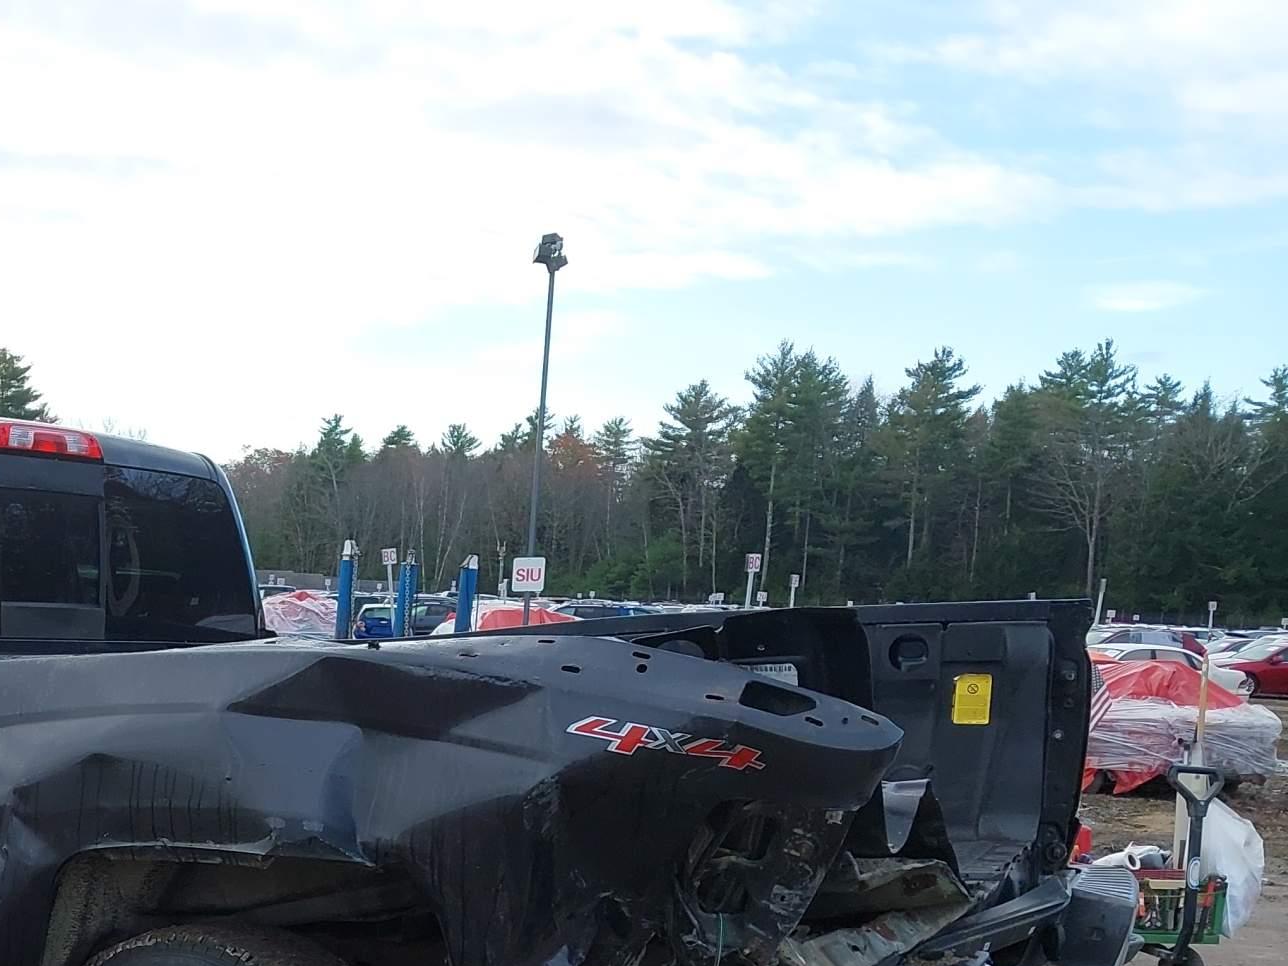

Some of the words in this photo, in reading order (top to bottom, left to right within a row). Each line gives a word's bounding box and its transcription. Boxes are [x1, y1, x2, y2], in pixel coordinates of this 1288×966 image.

[383, 550, 396, 562] BC
[748, 555, 761, 570] BC
[515, 567, 542, 582] SIU
